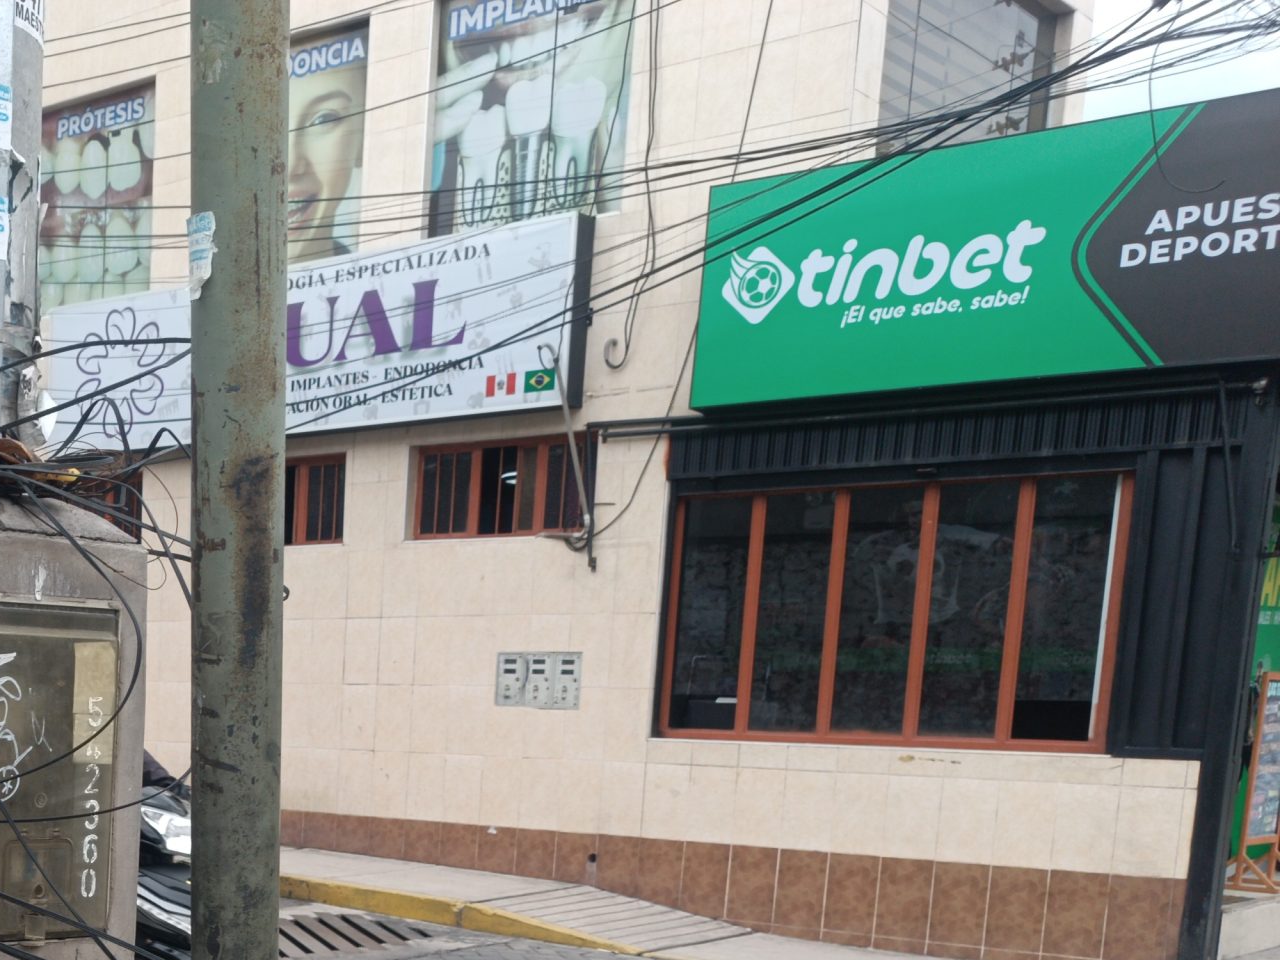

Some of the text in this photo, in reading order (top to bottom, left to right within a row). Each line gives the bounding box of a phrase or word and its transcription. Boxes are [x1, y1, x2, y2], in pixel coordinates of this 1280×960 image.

[56, 97, 145, 140] PRÓTESIS
[334, 242, 491, 284] ESPECIALIZADA
[797, 219, 1047, 308] tinbet
[869, 304, 906, 325] que
[970, 285, 1031, 310] sabe!
[290, 355, 484, 393] IMPLANTES ENDODONCIA
[332, 393, 370, 410] ORAL
